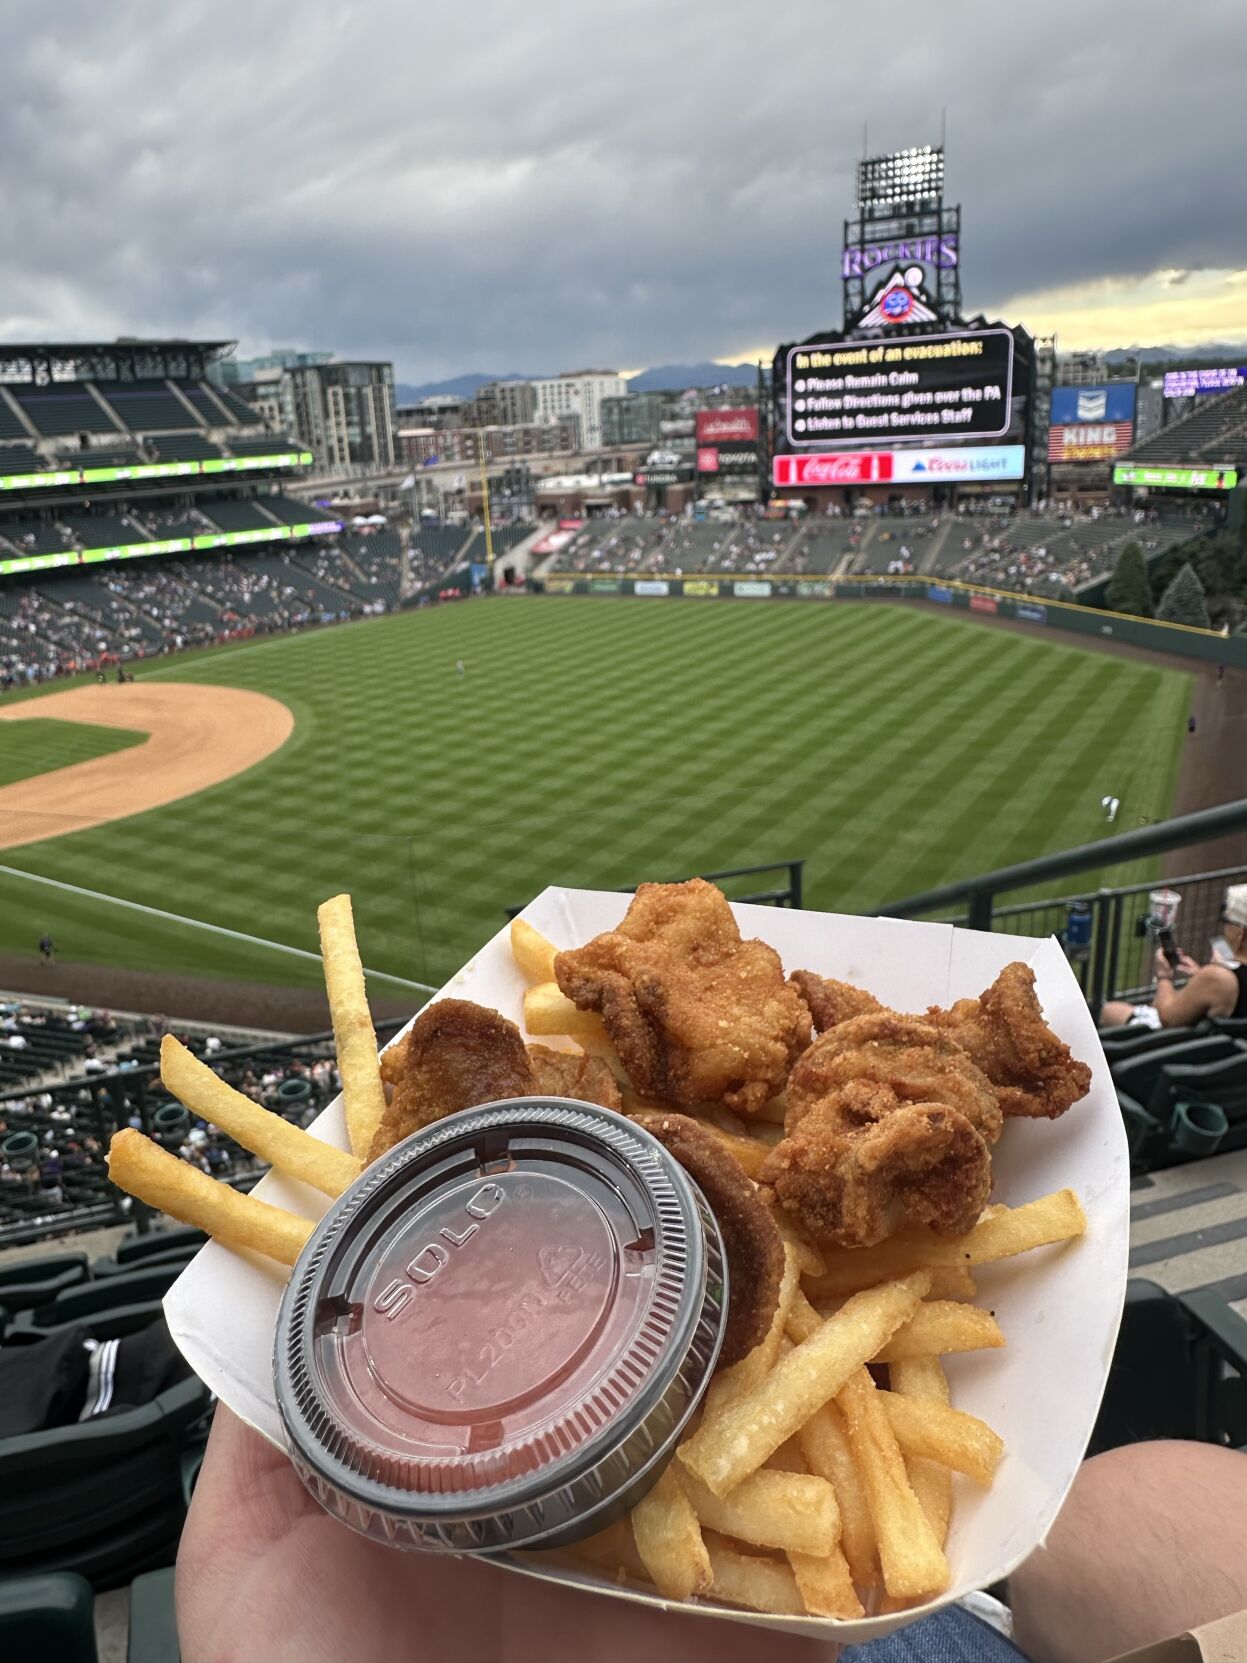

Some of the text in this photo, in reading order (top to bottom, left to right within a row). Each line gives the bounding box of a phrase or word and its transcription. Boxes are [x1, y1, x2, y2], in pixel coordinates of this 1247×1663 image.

[841, 235, 958, 278] ROCKIES
[811, 352, 832, 368] the
[833, 348, 868, 366] event
[868, 346, 884, 363] of
[884, 347, 902, 362] an
[806, 385, 1001, 412] Follow Directions given over the PA
[806, 407, 973, 431] Listen to Guest Services Staff
[374, 1182, 506, 1321] SOLO
